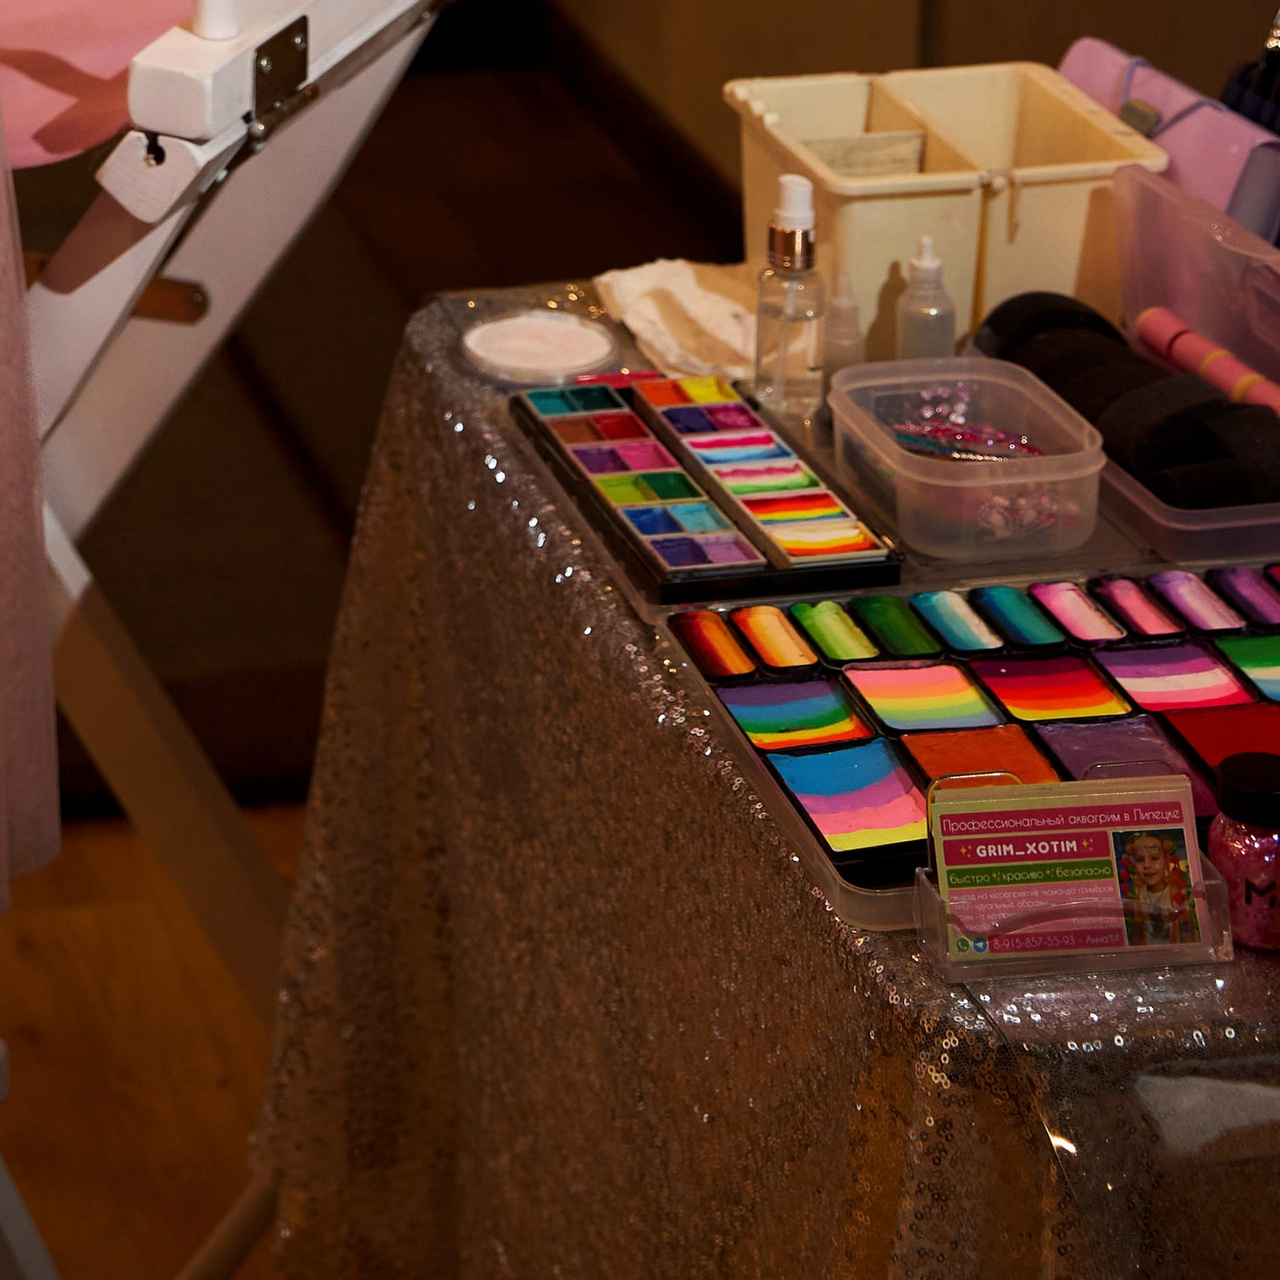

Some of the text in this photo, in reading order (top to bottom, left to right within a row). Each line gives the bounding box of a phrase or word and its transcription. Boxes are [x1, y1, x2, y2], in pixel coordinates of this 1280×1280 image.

[943, 808, 1180, 832] Профессиональный аквагрим в Липецке
[976, 840, 1078, 858] GRIM_XOTIM
[949, 866, 1111, 885] быстро красиво безопасно
